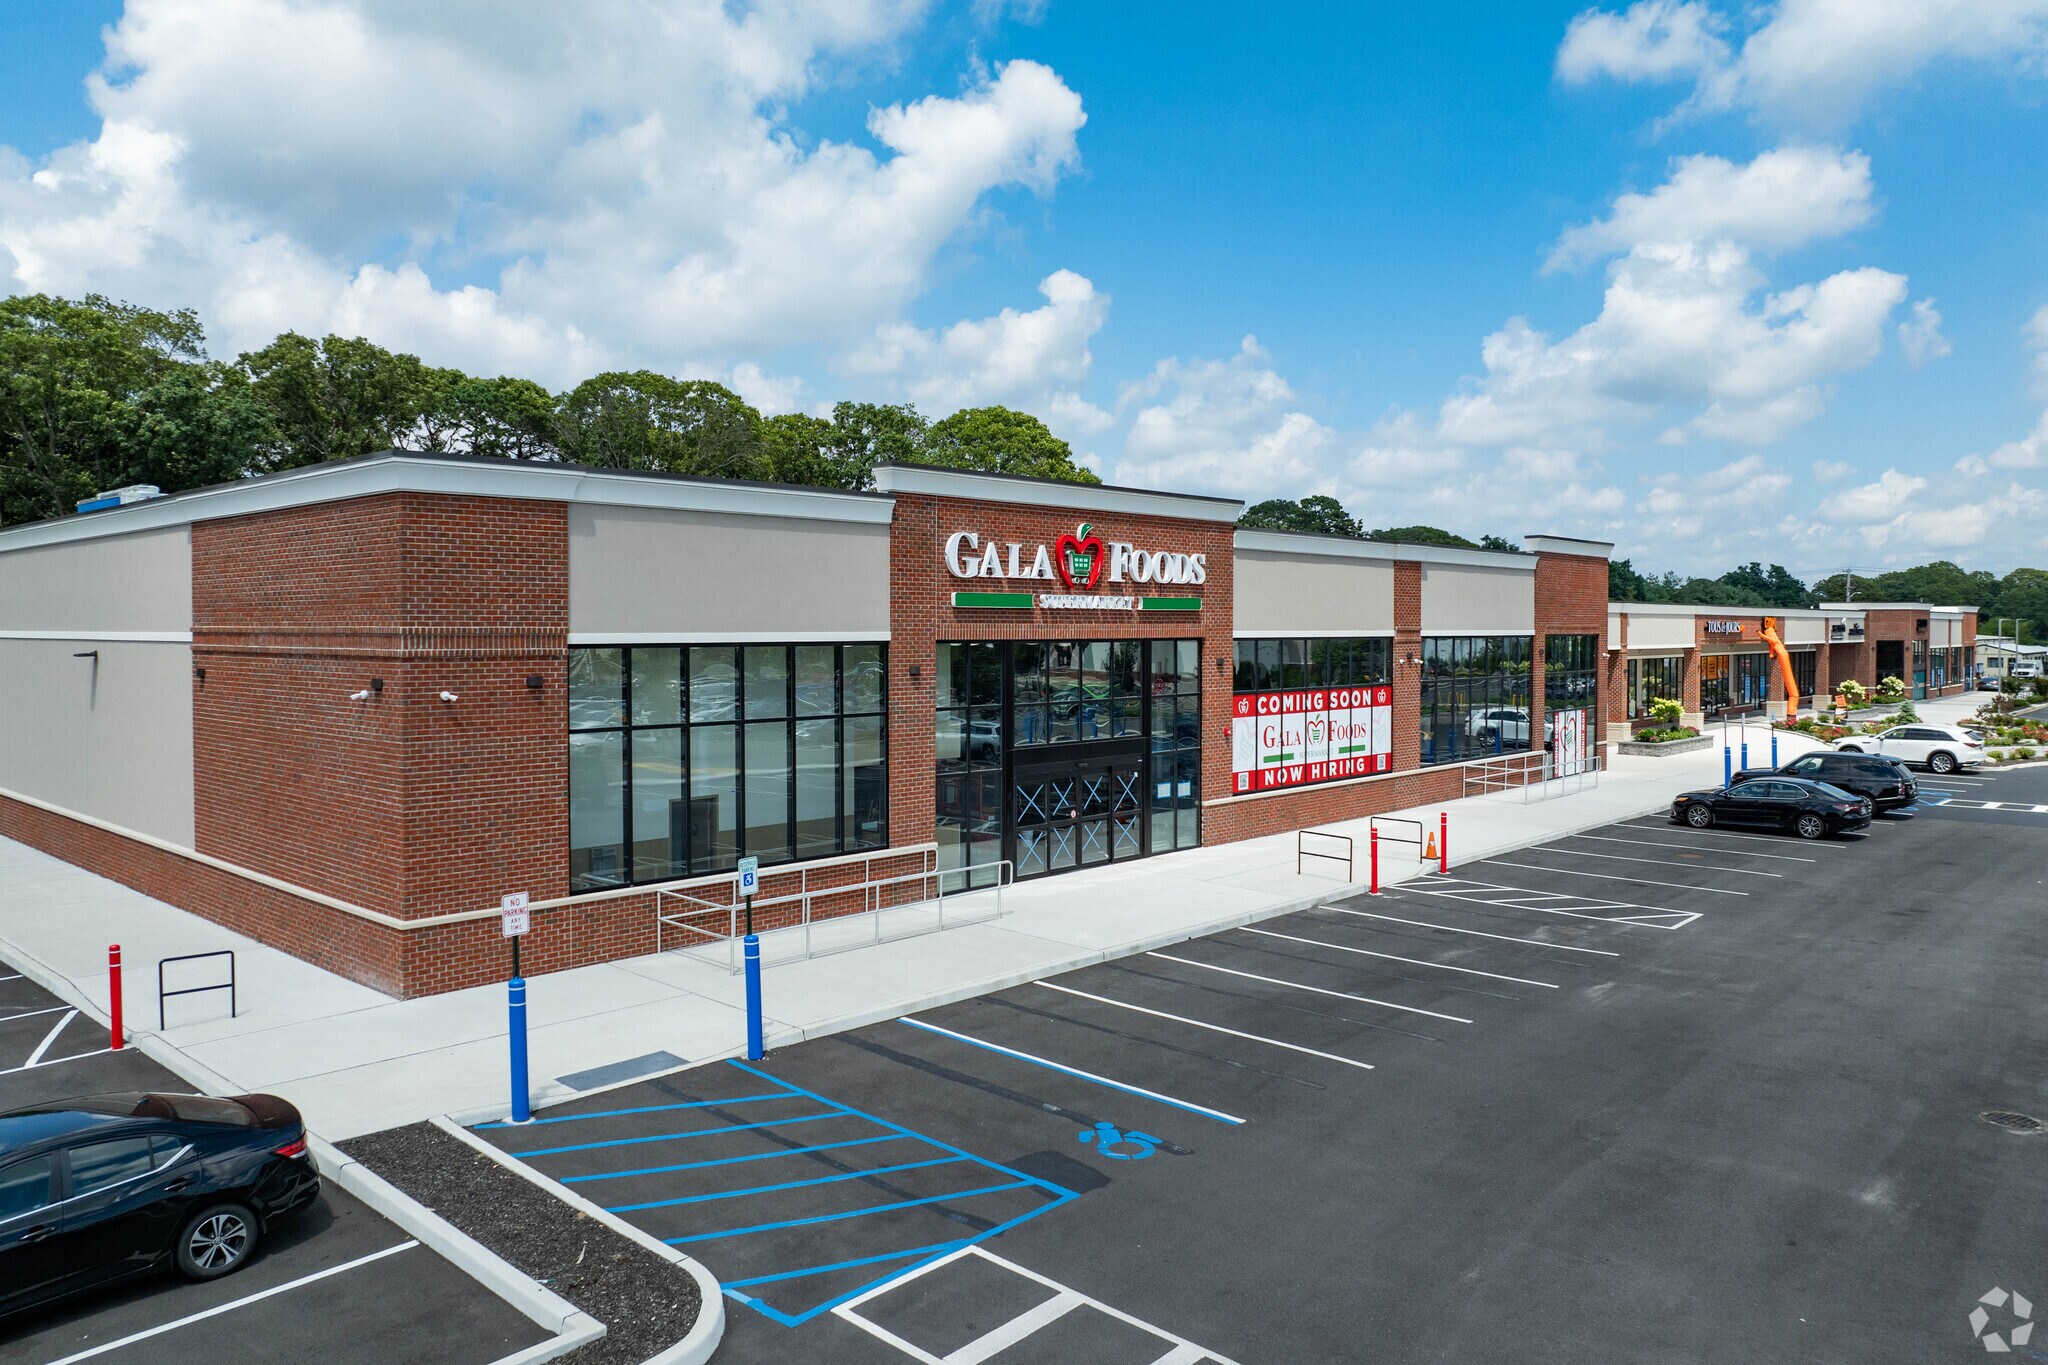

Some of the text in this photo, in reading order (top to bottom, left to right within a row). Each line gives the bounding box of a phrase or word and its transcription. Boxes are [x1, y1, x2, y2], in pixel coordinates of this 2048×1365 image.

[944, 531, 1206, 585] GALA FOODS
[1039, 594, 1135, 610] SUPERMARKET
[1257, 689, 1371, 714] COMING SOON
[1263, 720, 1367, 749] GALA FOODS
[1299, 748, 1334, 759] SUERMARKT
[1264, 757, 1365, 786] NOW HIRING
[504, 906, 527, 916] PARKING
[510, 898, 520, 906] NO
